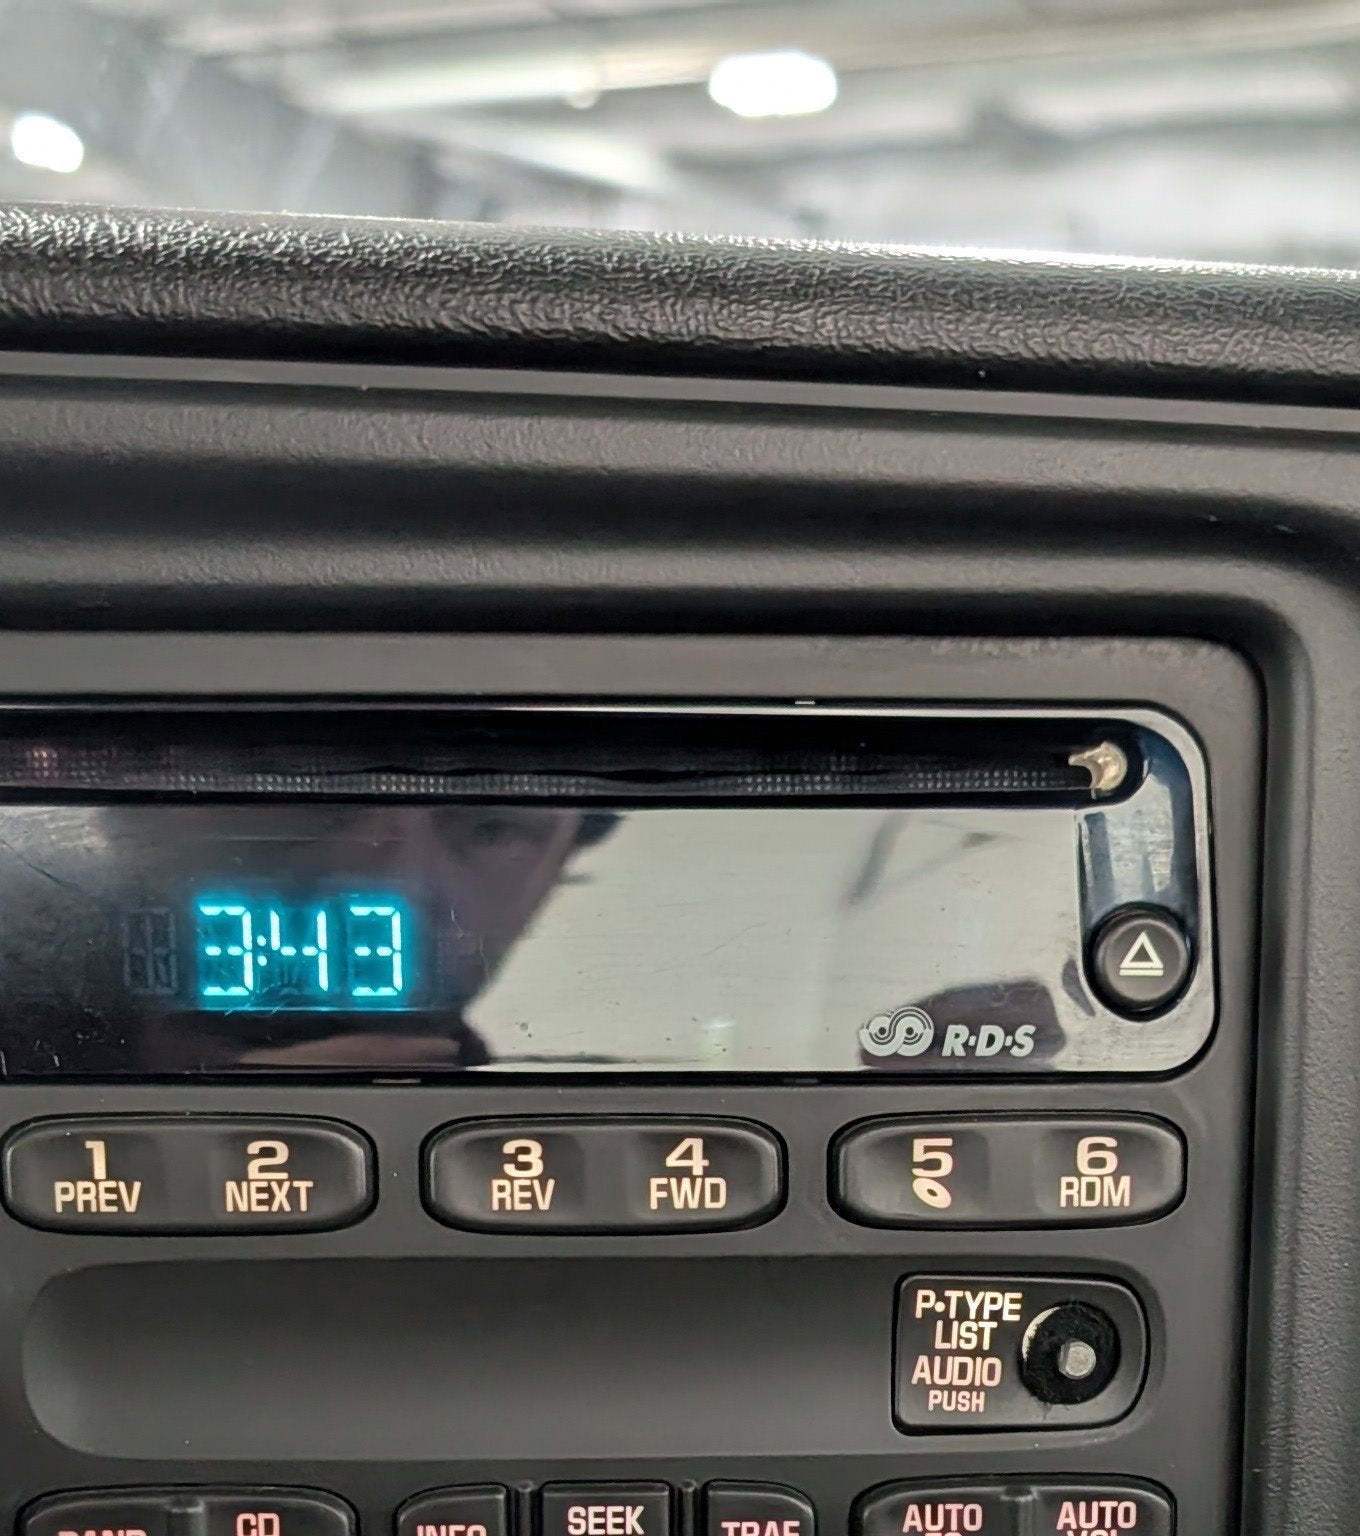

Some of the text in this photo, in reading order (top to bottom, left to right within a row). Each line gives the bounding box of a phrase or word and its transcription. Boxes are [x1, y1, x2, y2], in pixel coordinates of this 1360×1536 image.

[200, 902, 404, 998] 3:43
[85, 1140, 107, 1181] 1
[246, 1140, 289, 1180] 2
[502, 1138, 544, 1178] 3
[665, 1137, 710, 1176] 4
[911, 1137, 954, 1178] 5
[1076, 1136, 1119, 1174] 6
[54, 1181, 142, 1213] PREV
[225, 1180, 314, 1212] NEXT
[491, 1178, 555, 1212] REV
[649, 1177, 727, 1210] FWD
[1059, 1176, 1132, 1209] RDM
[934, 1319, 998, 1351] LIST
[911, 1355, 1002, 1387] AUDIO
[928, 1389, 986, 1413] PUSH
[567, 1505, 645, 1536] SEEK
[902, 1503, 983, 1534] AUTO
[1056, 1500, 1137, 1531] AUTO
